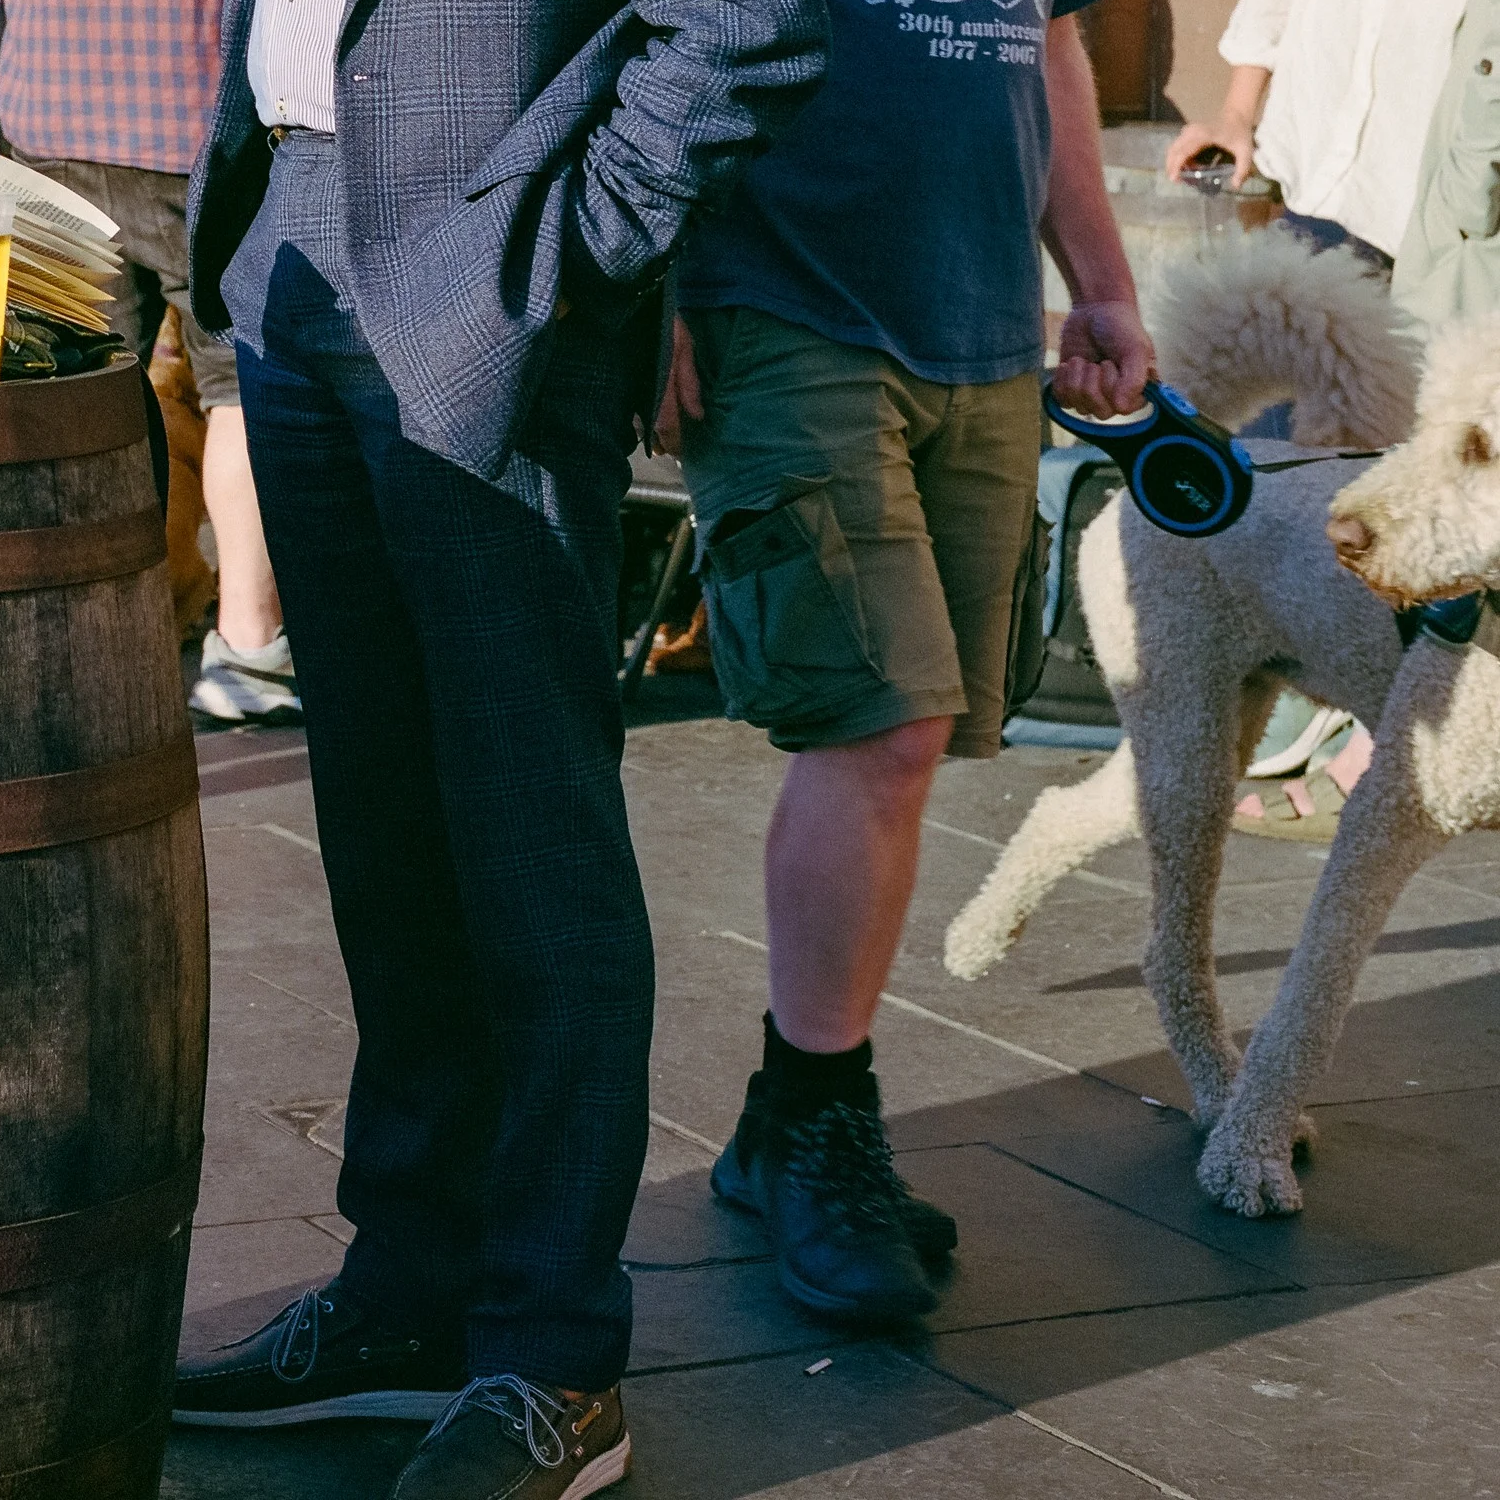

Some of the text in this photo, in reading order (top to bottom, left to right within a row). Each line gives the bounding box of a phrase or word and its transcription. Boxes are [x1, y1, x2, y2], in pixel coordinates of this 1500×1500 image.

[898, 12, 954, 38] 30th
[928, 38, 978, 61] 1977
[996, 43, 1036, 65] 2007
